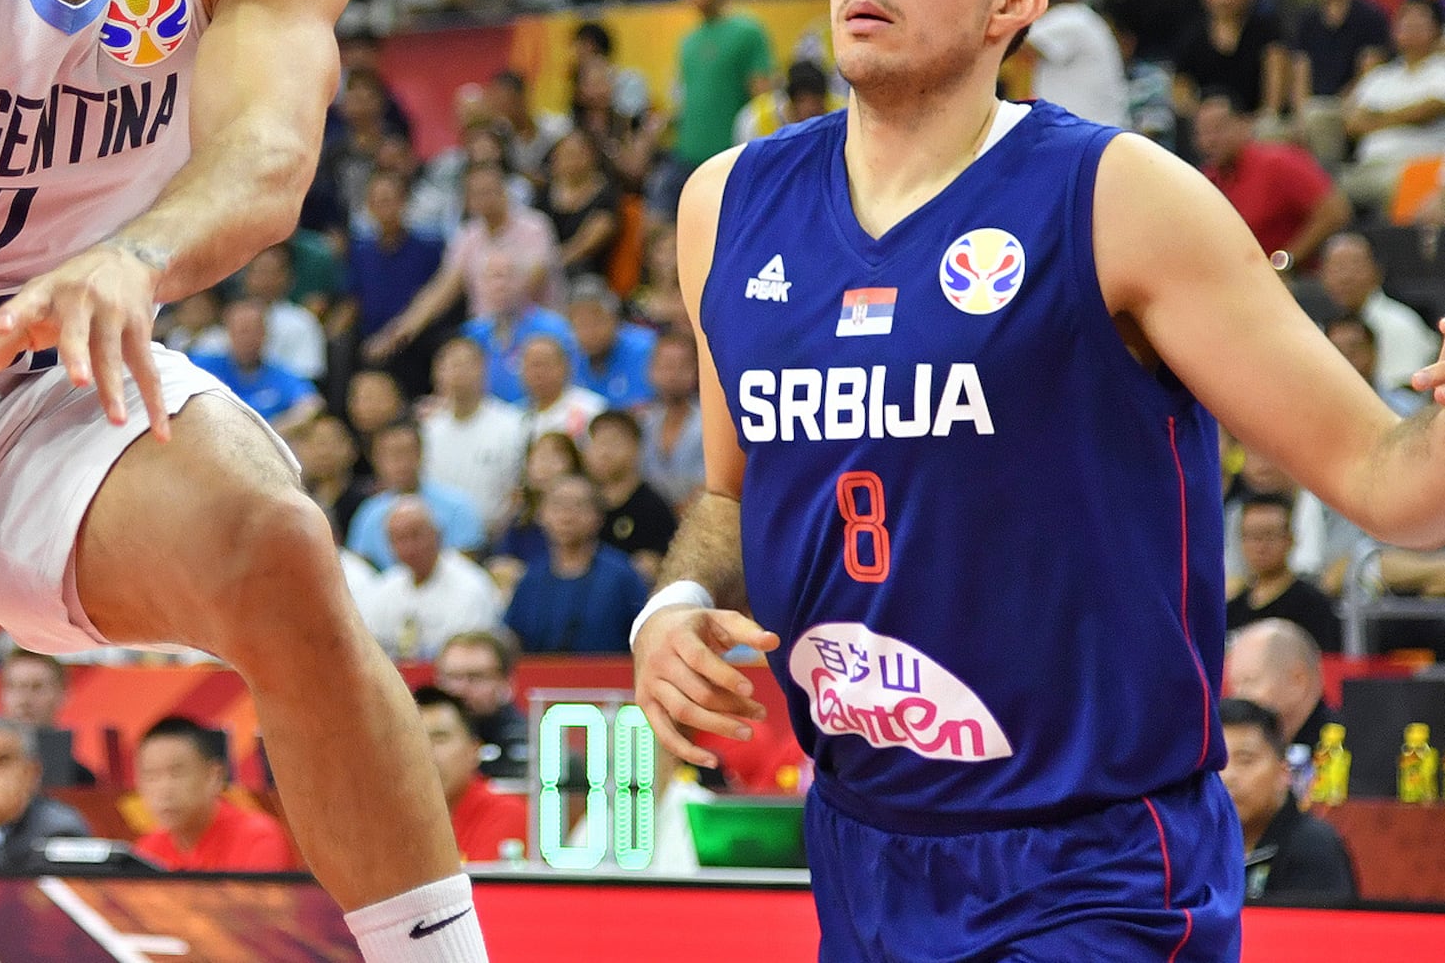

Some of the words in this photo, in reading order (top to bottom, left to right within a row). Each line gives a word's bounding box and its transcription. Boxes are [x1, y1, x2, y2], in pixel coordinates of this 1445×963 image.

[745, 277, 792, 302] PEAK
[739, 363, 995, 442] SRBIJA
[836, 471, 890, 583] 8
